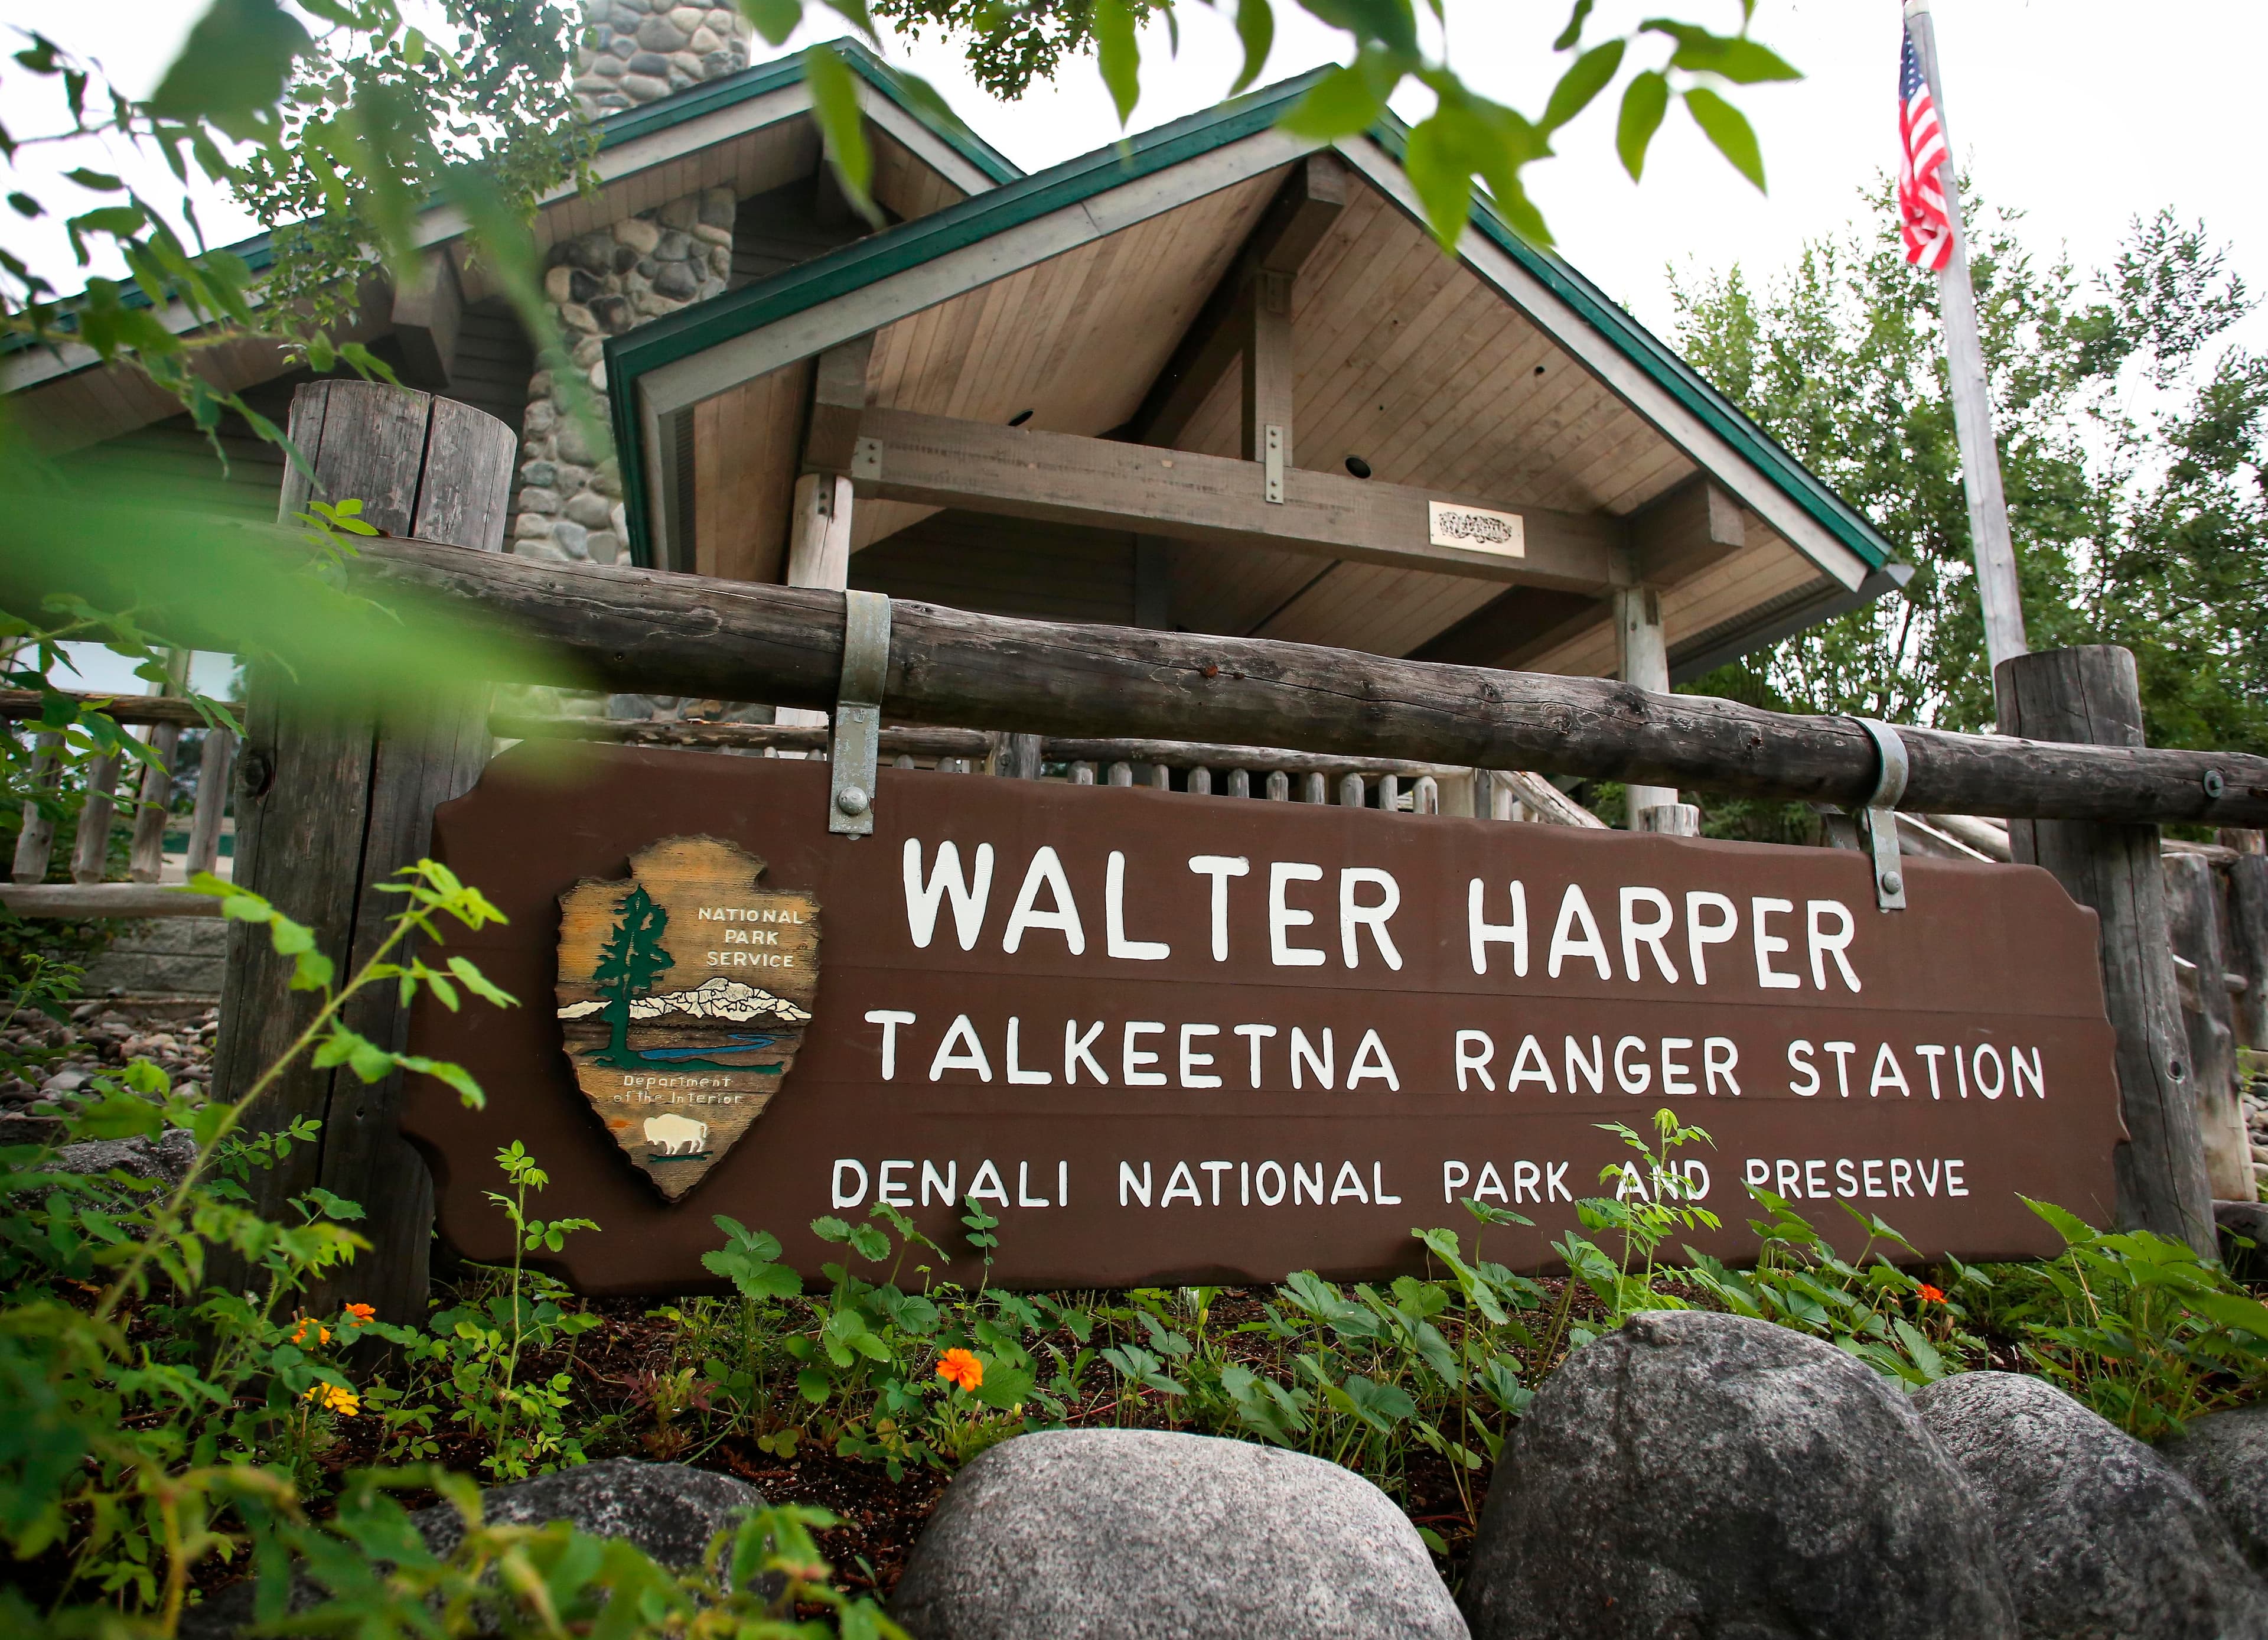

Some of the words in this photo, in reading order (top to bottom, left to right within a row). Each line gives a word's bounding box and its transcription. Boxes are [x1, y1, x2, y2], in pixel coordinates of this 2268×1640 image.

[698, 907, 804, 924] NATIONAL
[903, 838, 1403, 971] WALTER
[1468, 878, 1862, 993] HARPER
[725, 929, 779, 945] PARK
[706, 951, 794, 967] SERVICE
[864, 1010, 1400, 1092] TALKEETNA
[1455, 1030, 1741, 1096] RANGER
[1787, 1039, 2045, 1100] STATION
[624, 1075, 731, 1089] Department
[614, 1091, 633, 1102] of
[637, 1091, 662, 1103] the
[671, 1092, 742, 1104] Interior
[832, 1159, 1067, 1209] DENALI
[1119, 1160, 1402, 1208] NATIONAL
[1443, 1160, 1573, 1204] PARK
[1615, 1159, 1710, 1202] AND
[1746, 1158, 1969, 1199] PRESERVE
